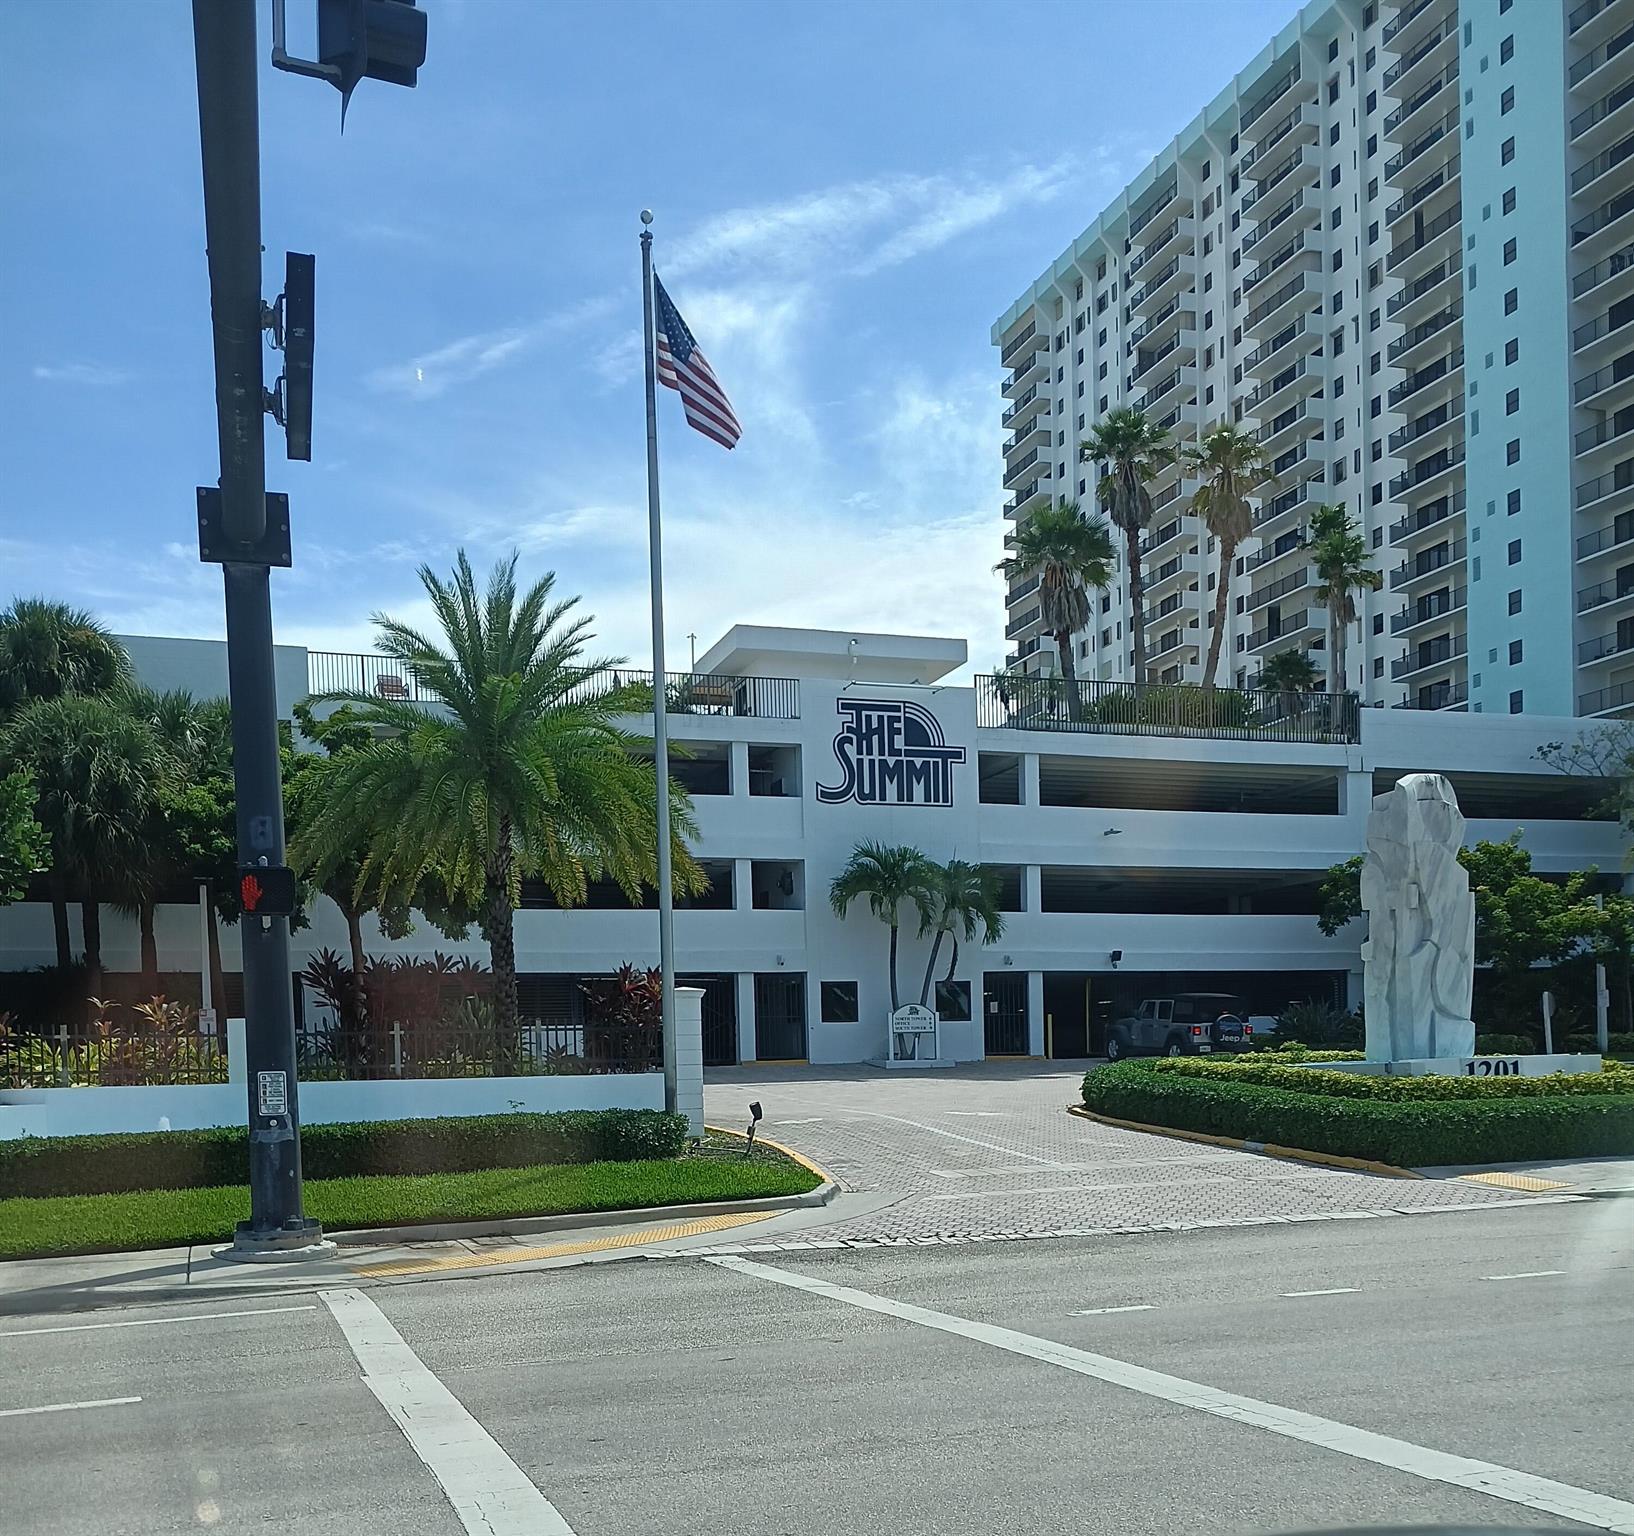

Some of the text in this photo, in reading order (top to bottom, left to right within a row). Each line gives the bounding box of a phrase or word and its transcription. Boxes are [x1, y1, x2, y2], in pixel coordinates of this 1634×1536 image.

[838, 700, 903, 757] THE
[818, 735, 964, 805] SUMMIT
[1220, 1034, 1240, 1043] Jeep
[1465, 1060, 1519, 1076] 1201
